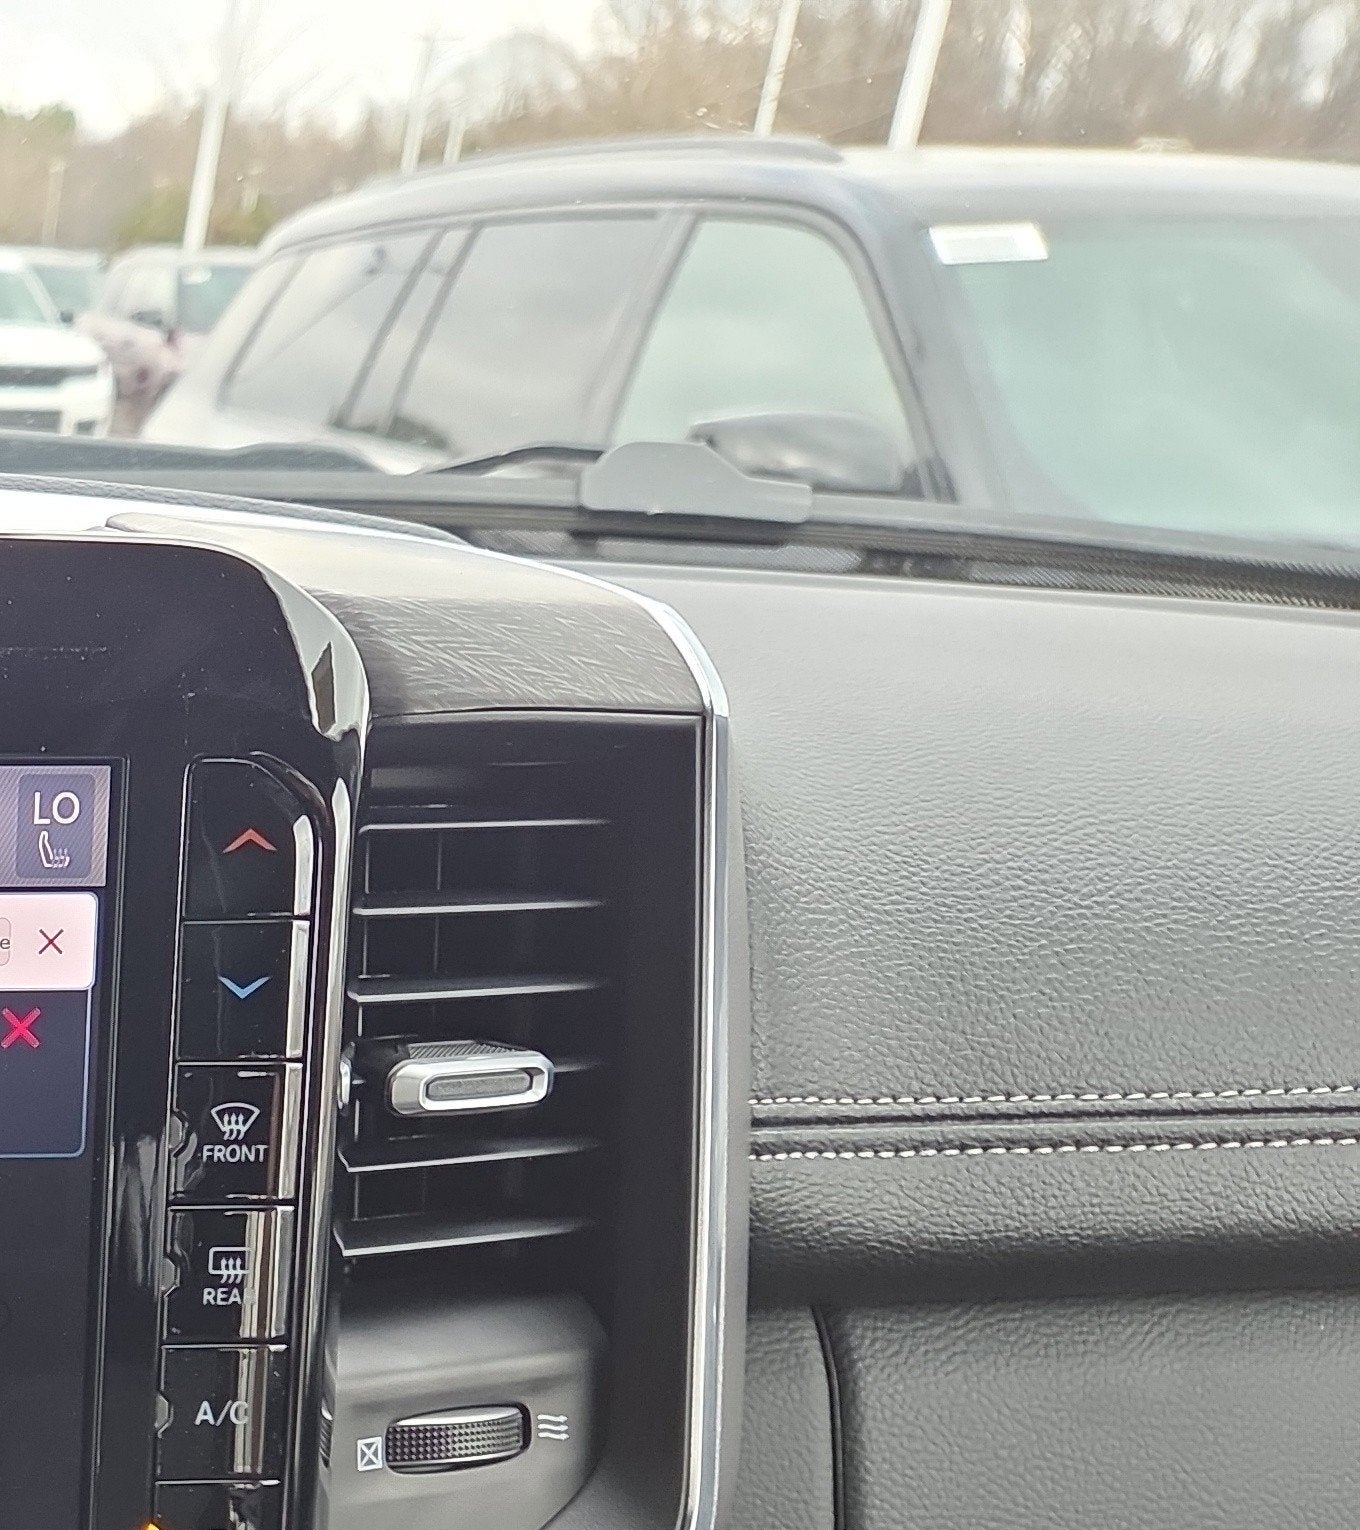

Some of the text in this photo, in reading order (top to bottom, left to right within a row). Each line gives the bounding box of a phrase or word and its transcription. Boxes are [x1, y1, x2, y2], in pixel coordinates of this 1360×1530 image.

[33, 791, 80, 826] LO
[202, 1144, 268, 1163] FRONT
[194, 1400, 249, 1427] A/C
